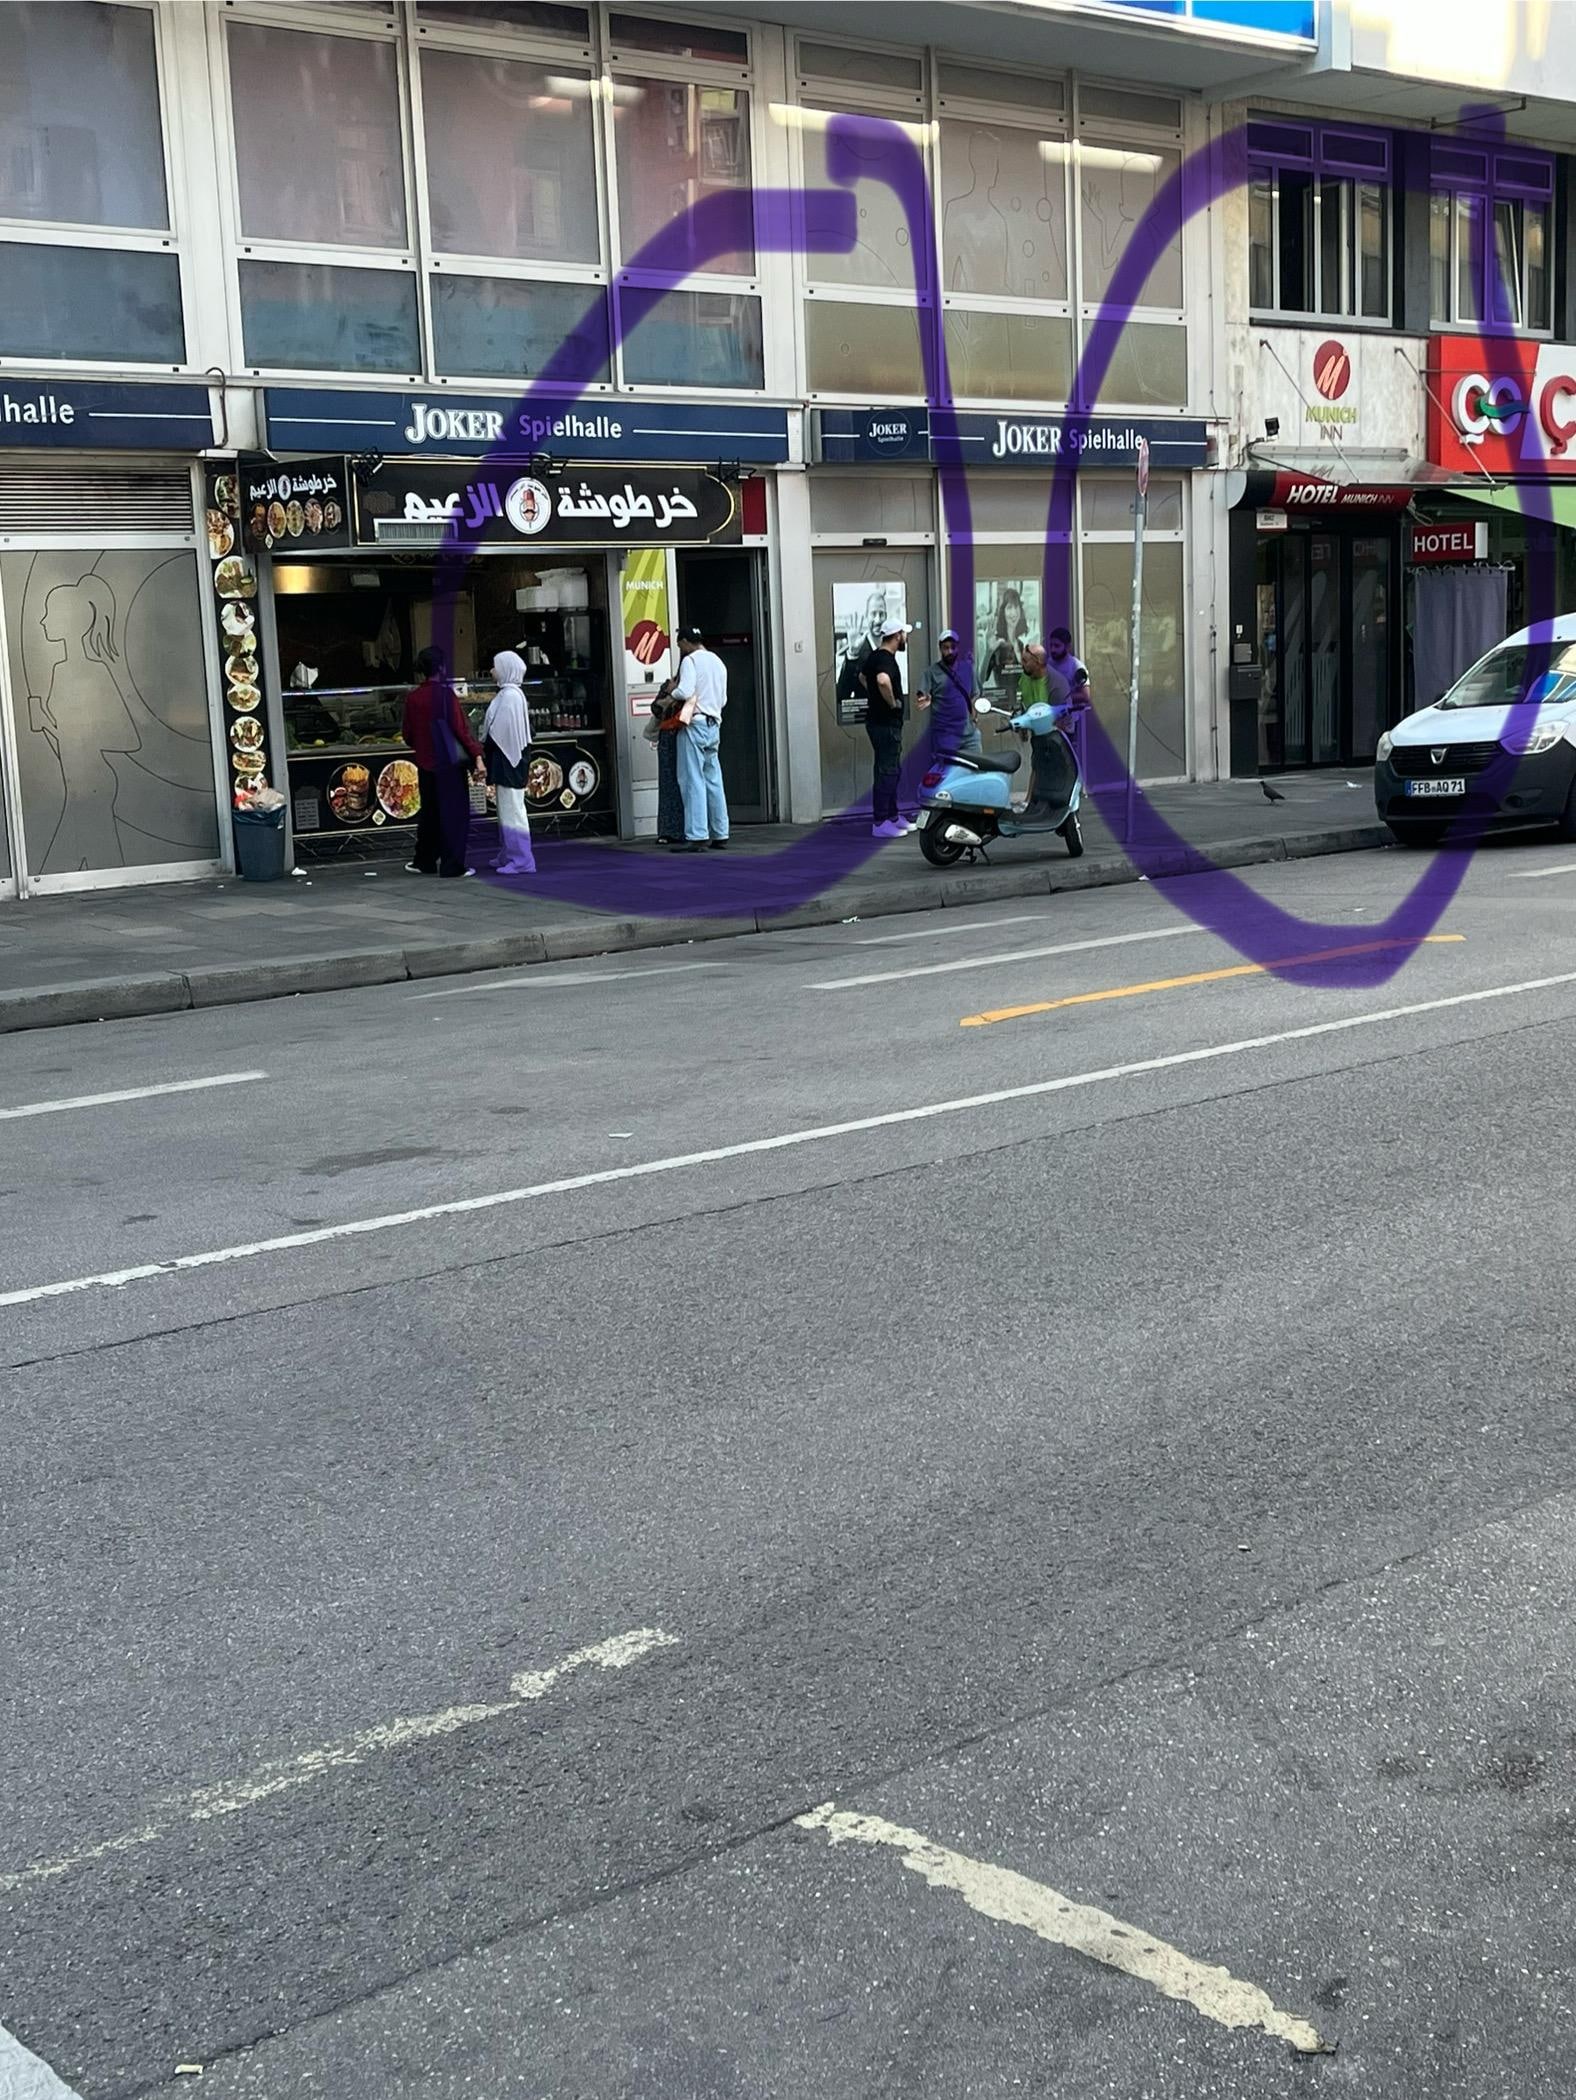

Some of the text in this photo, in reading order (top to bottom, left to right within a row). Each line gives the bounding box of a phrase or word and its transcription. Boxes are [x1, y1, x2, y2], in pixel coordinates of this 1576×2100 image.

[0, 394, 75, 424] halle
[1305, 406, 1357, 424] MUNICH
[404, 402, 622, 444] JOKER Spielhalle
[869, 423, 907, 438] JOKER
[1320, 425, 1343, 440] INN
[992, 419, 1143, 458] JOKER Spielhalle
[292, 473, 338, 496] خرطوشة
[1286, 484, 1339, 504] HOTEL
[1340, 494, 1378, 505] MUNICH
[404, 482, 698, 529] خرطوشة الزعيم
[1414, 533, 1473, 553] HOTEL
[625, 581, 664, 591] MUNICH
[1450, 780, 1463, 792] 71
